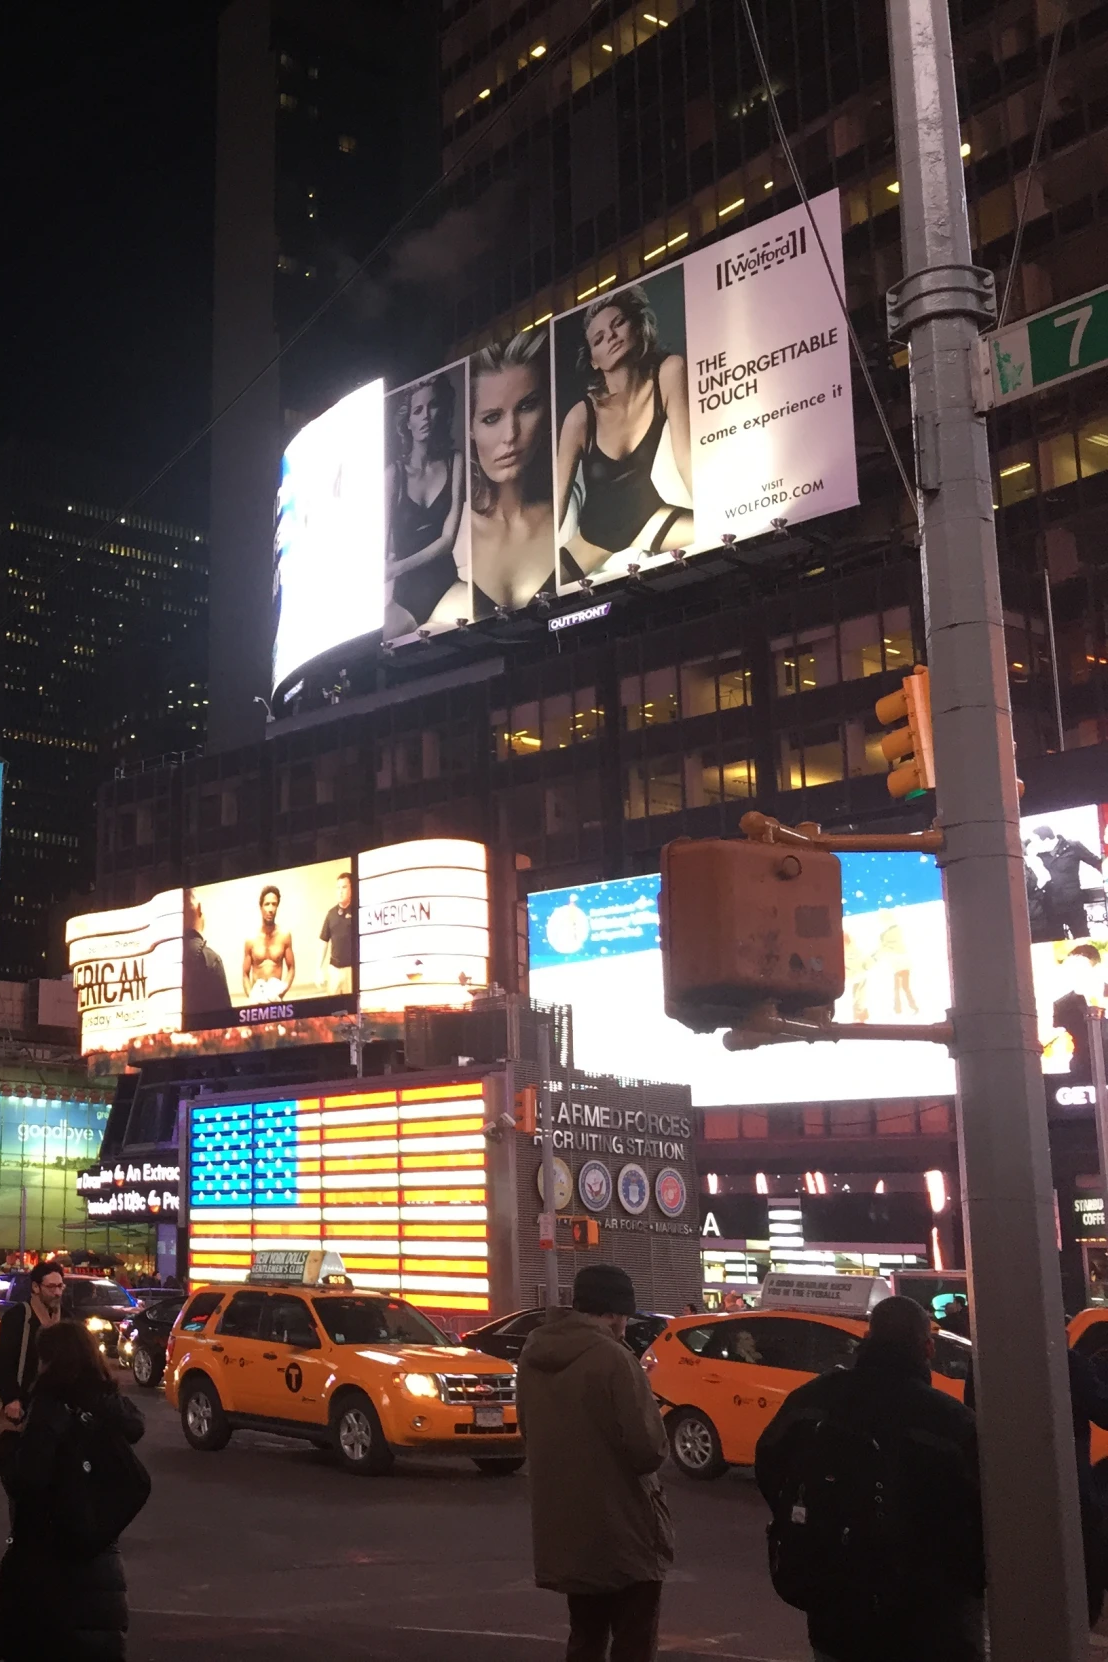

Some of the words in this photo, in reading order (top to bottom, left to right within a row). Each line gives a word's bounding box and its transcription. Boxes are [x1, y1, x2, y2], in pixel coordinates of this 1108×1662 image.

[731, 240, 790, 276] Wolford
[1053, 305, 1092, 367] 7
[696, 351, 727, 376] THE
[698, 328, 839, 395] UNFORGETTABLE
[698, 379, 758, 414] TOUCH
[700, 425, 737, 446] come
[743, 392, 826, 428] experience
[832, 384, 843, 399] it
[761, 478, 784, 492] VISIT
[725, 479, 824, 519] WOLFORD.COM
[550, 605, 608, 630] OUTFRONT
[367, 902, 430, 925] AMERICAN
[239, 1004, 294, 1022] SIEMENS
[18, 1119, 94, 1146] goodbye
[557, 1102, 622, 1130] ARMED
[625, 1110, 690, 1138] FORCES
[534, 1128, 623, 1154] RCRUITING
[626, 1137, 684, 1160] STATION
[126, 1164, 141, 1181] An
[604, 1217, 618, 1229] AIR
[620, 1218, 648, 1232] FORCE
[655, 1221, 688, 1236] MARINES
[269, 1252, 287, 1264] YORK
[287, 1252, 308, 1264] DOLLS
[289, 1265, 303, 1273] CLUB
[767, 1288, 782, 1296] YOU
[792, 1289, 804, 1297] THE
